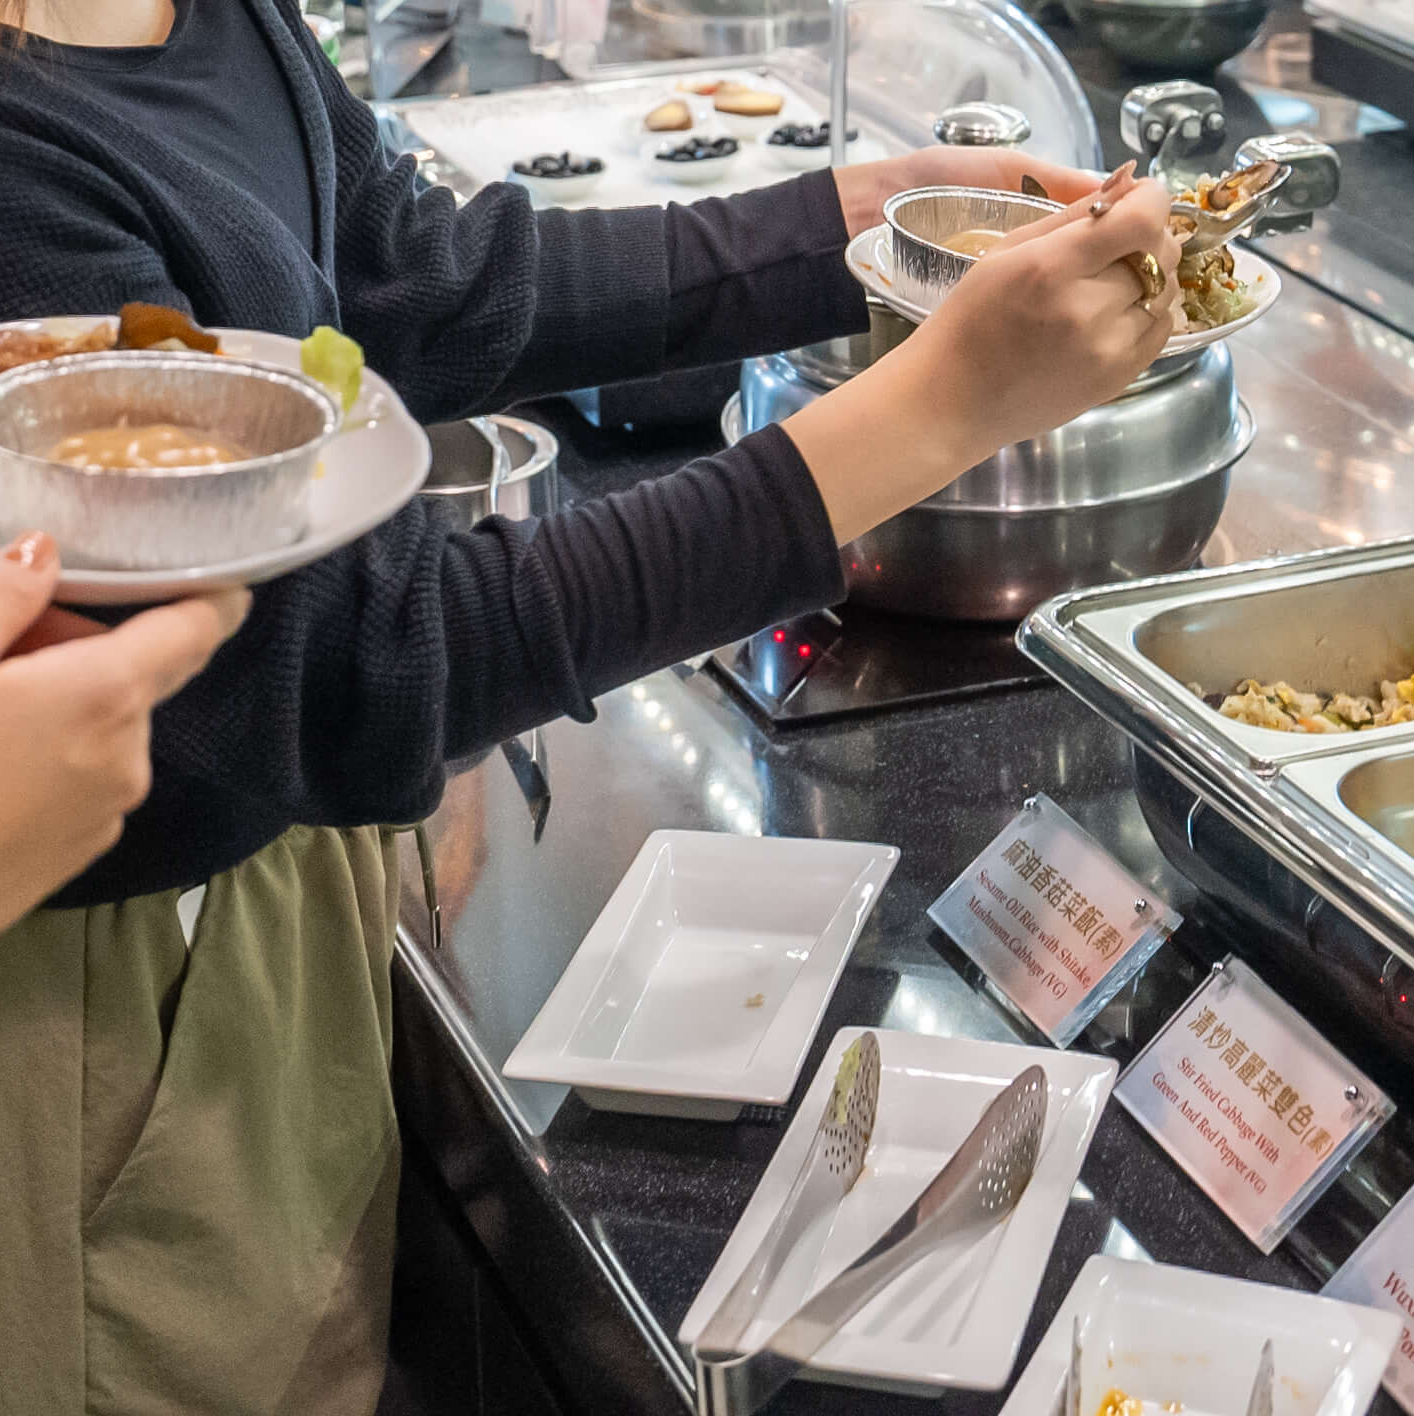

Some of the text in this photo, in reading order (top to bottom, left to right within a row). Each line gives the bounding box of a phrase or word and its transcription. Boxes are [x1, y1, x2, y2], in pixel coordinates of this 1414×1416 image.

[977, 869, 1008, 903] Sesame
[1005, 896, 1023, 918] Oil
[1019, 912, 1039, 935] Rice
[1037, 932, 1060, 953] with
[1042, 972, 1068, 1001] (VG)
[1152, 1071, 1268, 1196] Green And Red Pepper (VG)
[1177, 1056, 1280, 1167] Stir Fried Cabbage With
